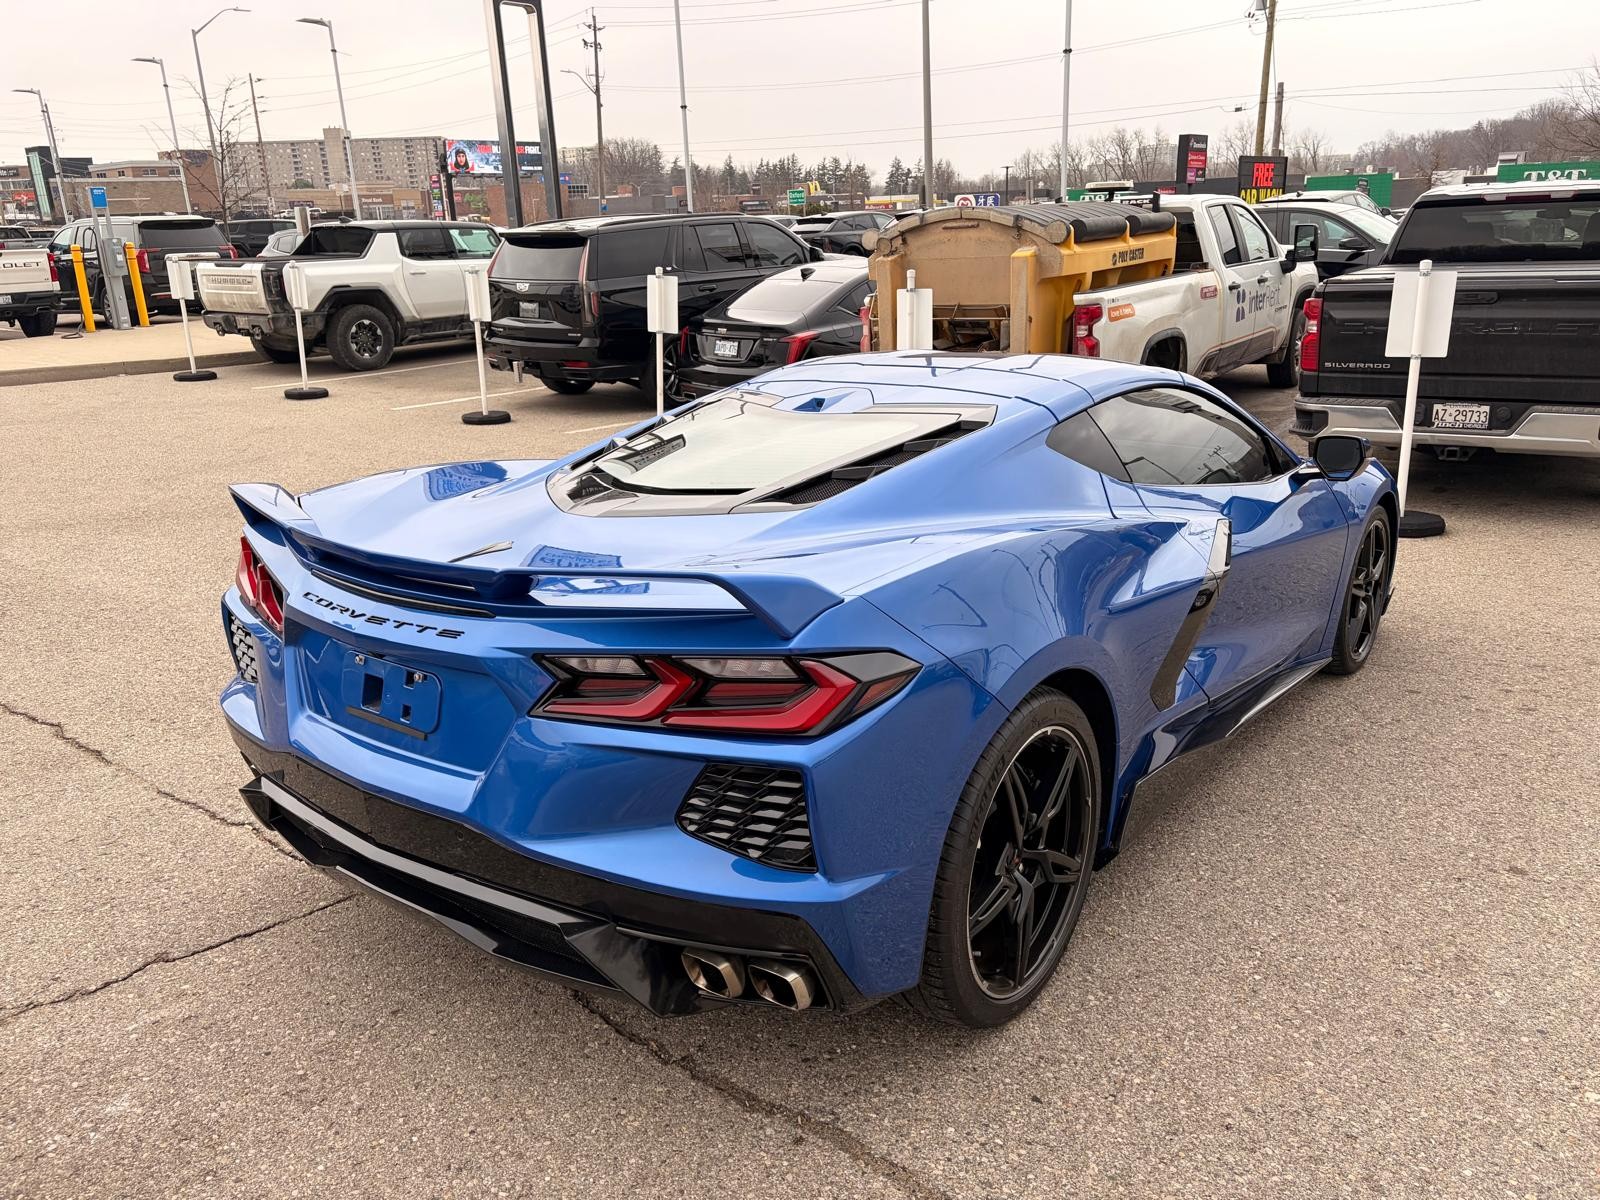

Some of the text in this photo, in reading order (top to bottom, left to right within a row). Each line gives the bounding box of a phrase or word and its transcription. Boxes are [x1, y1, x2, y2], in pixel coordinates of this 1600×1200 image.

[1252, 162, 1275, 187] FREE
[1240, 188, 1258, 205] CAR
[1453, 409, 1488, 423] 29733
[302, 591, 466, 640] CORVETTE
